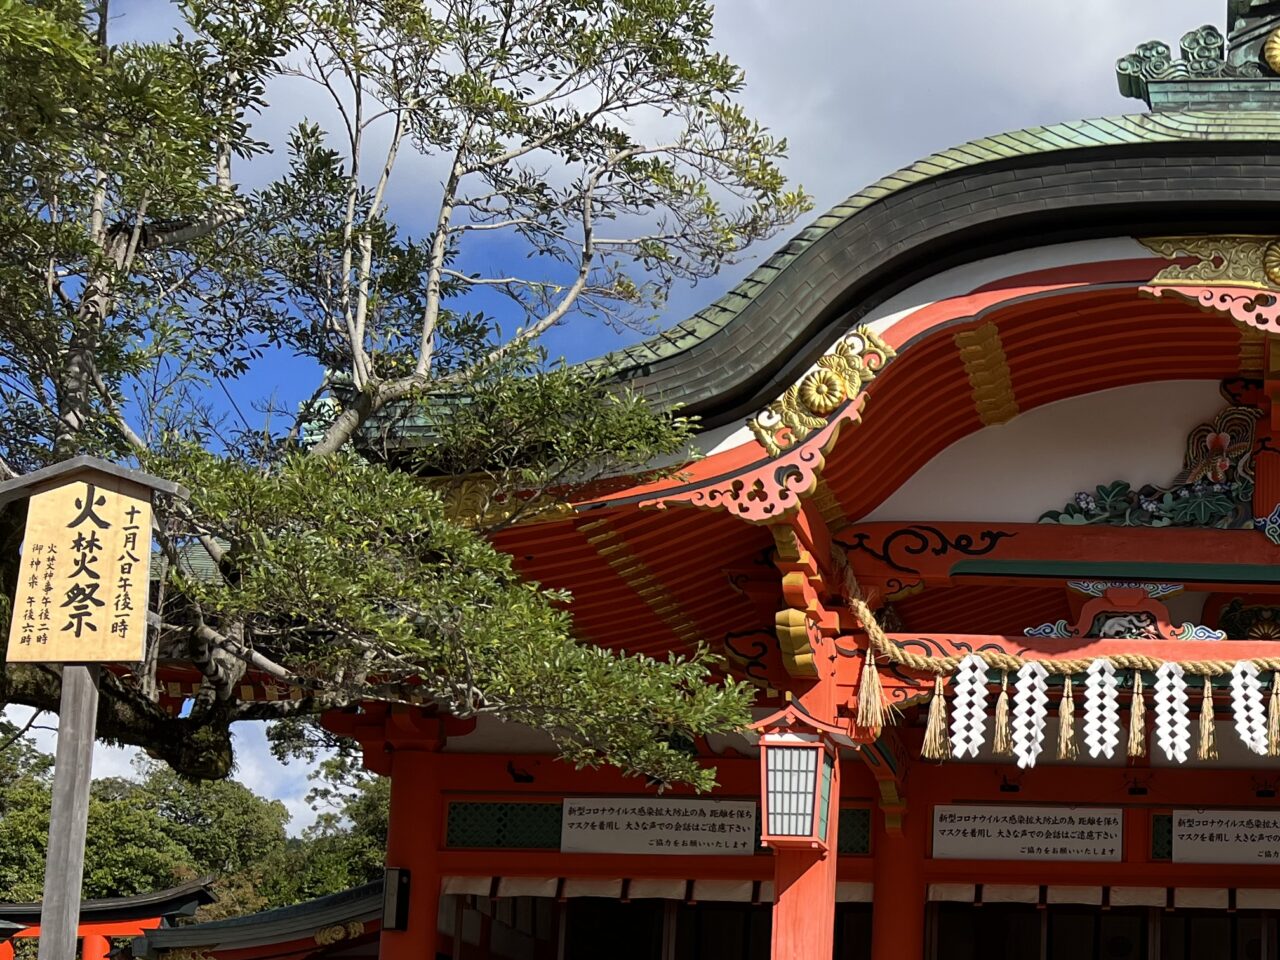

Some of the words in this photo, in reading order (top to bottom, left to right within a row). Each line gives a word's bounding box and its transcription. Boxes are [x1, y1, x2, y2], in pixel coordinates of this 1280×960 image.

[60, 484, 112, 637] 火焚祭
[111, 505, 142, 638] 十一月八日午後一時
